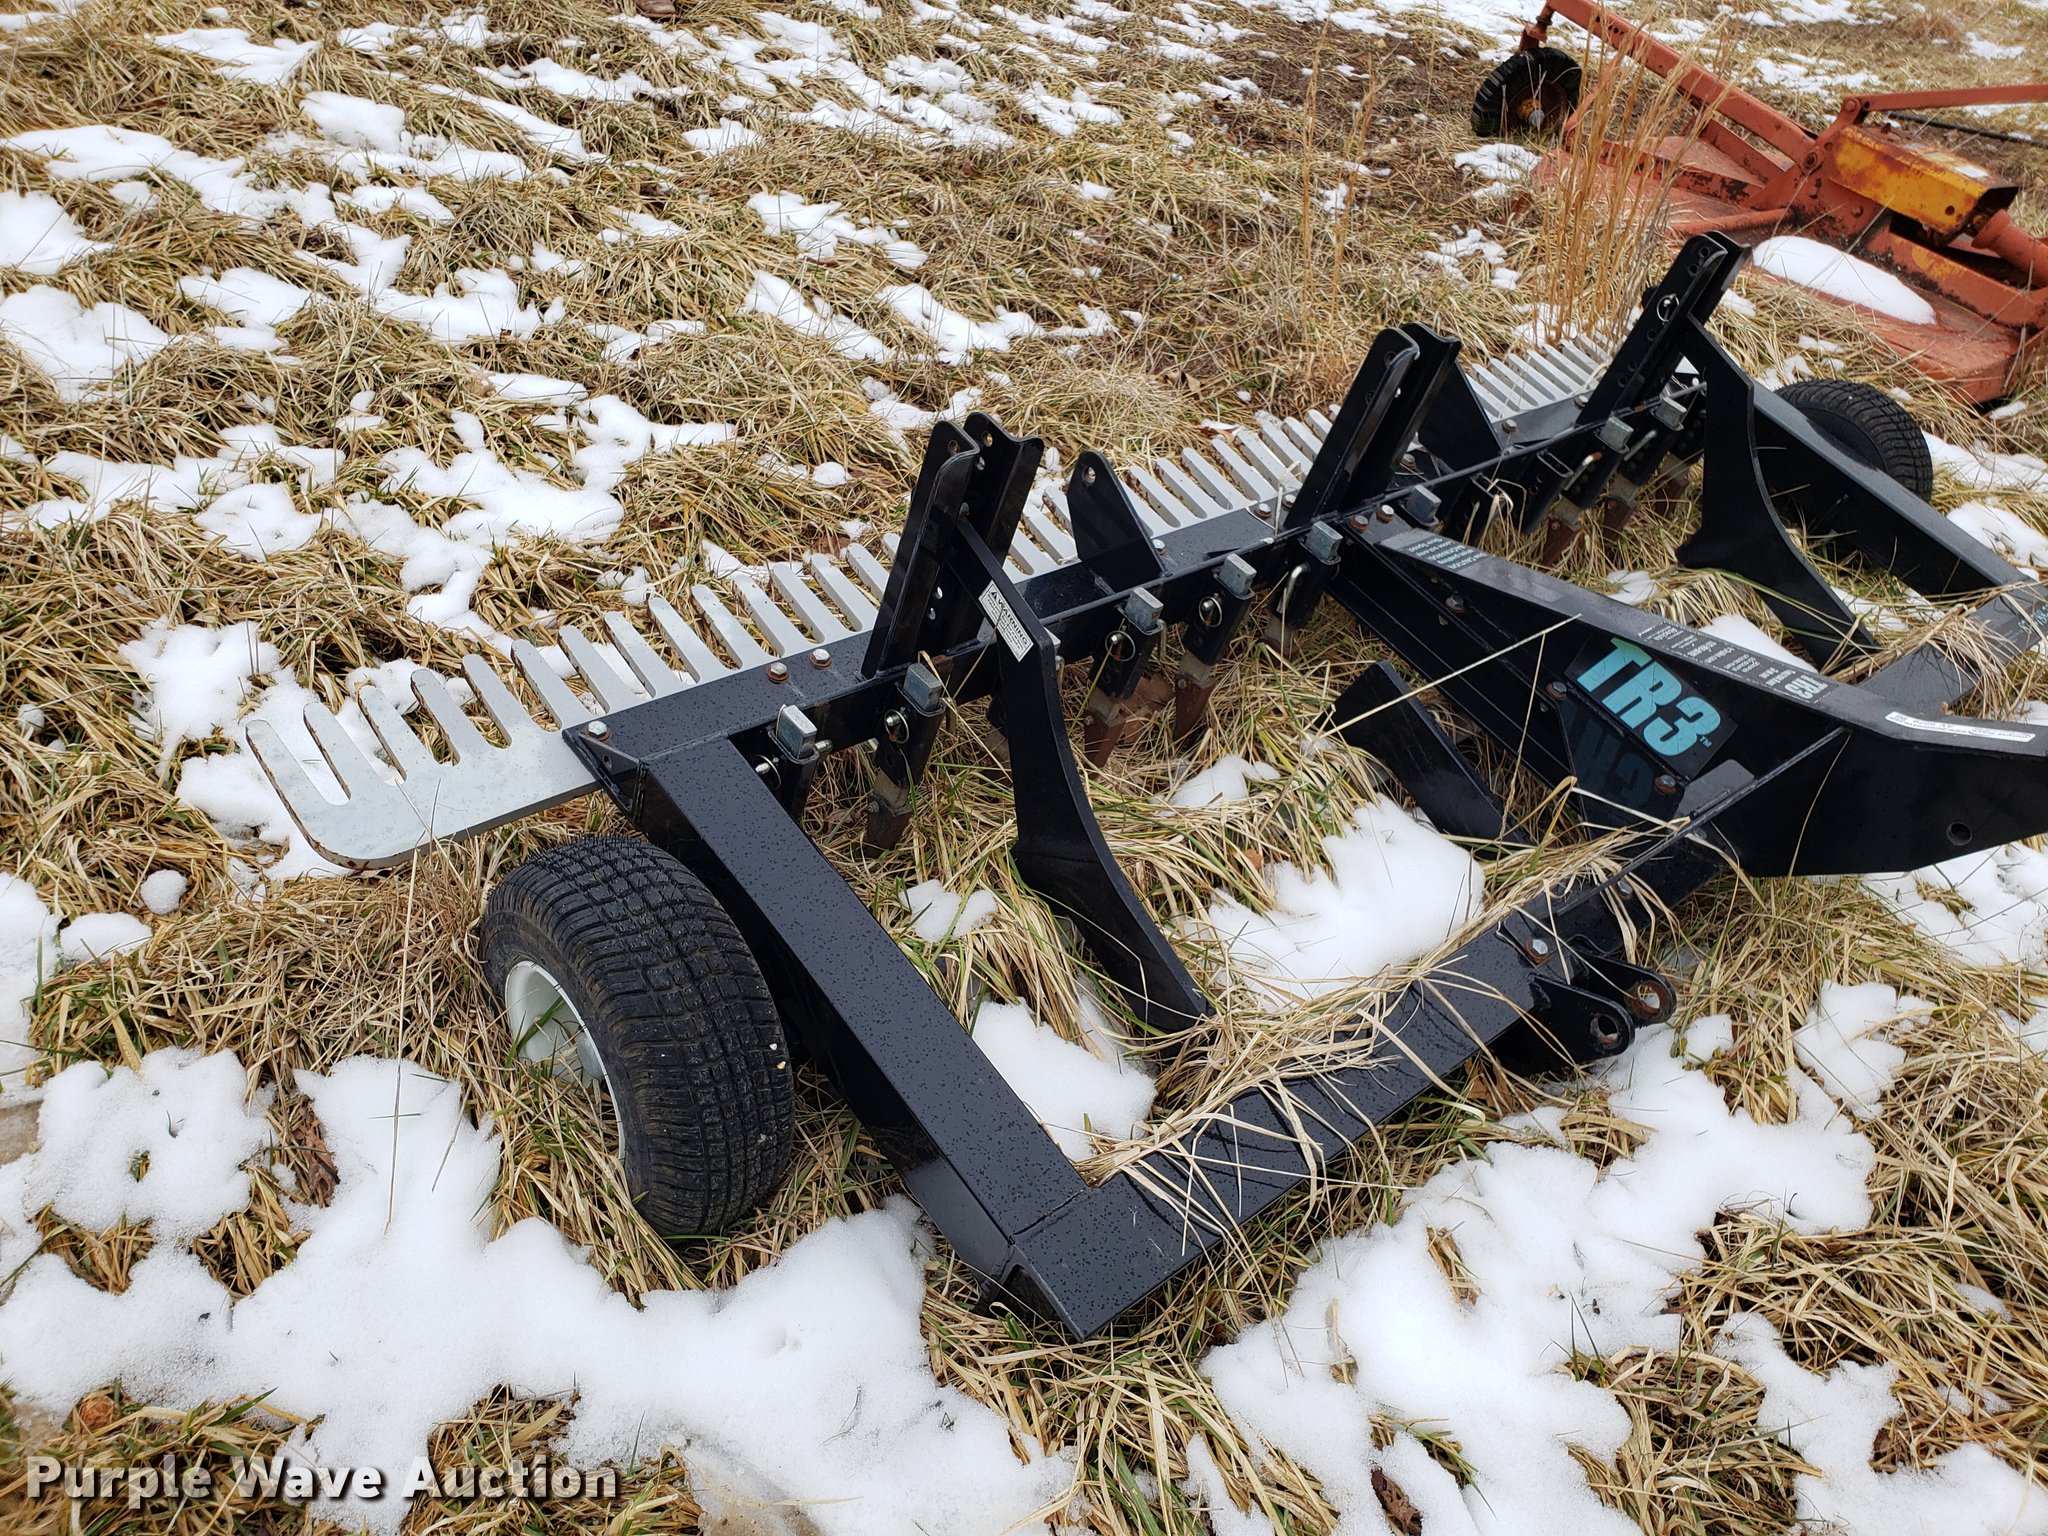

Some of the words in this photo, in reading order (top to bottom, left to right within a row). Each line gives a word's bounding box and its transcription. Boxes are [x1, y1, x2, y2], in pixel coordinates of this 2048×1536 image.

[998, 598, 1027, 645] WARNING
[1576, 637, 1721, 757] TR3
[1784, 674, 1829, 699] TR3
